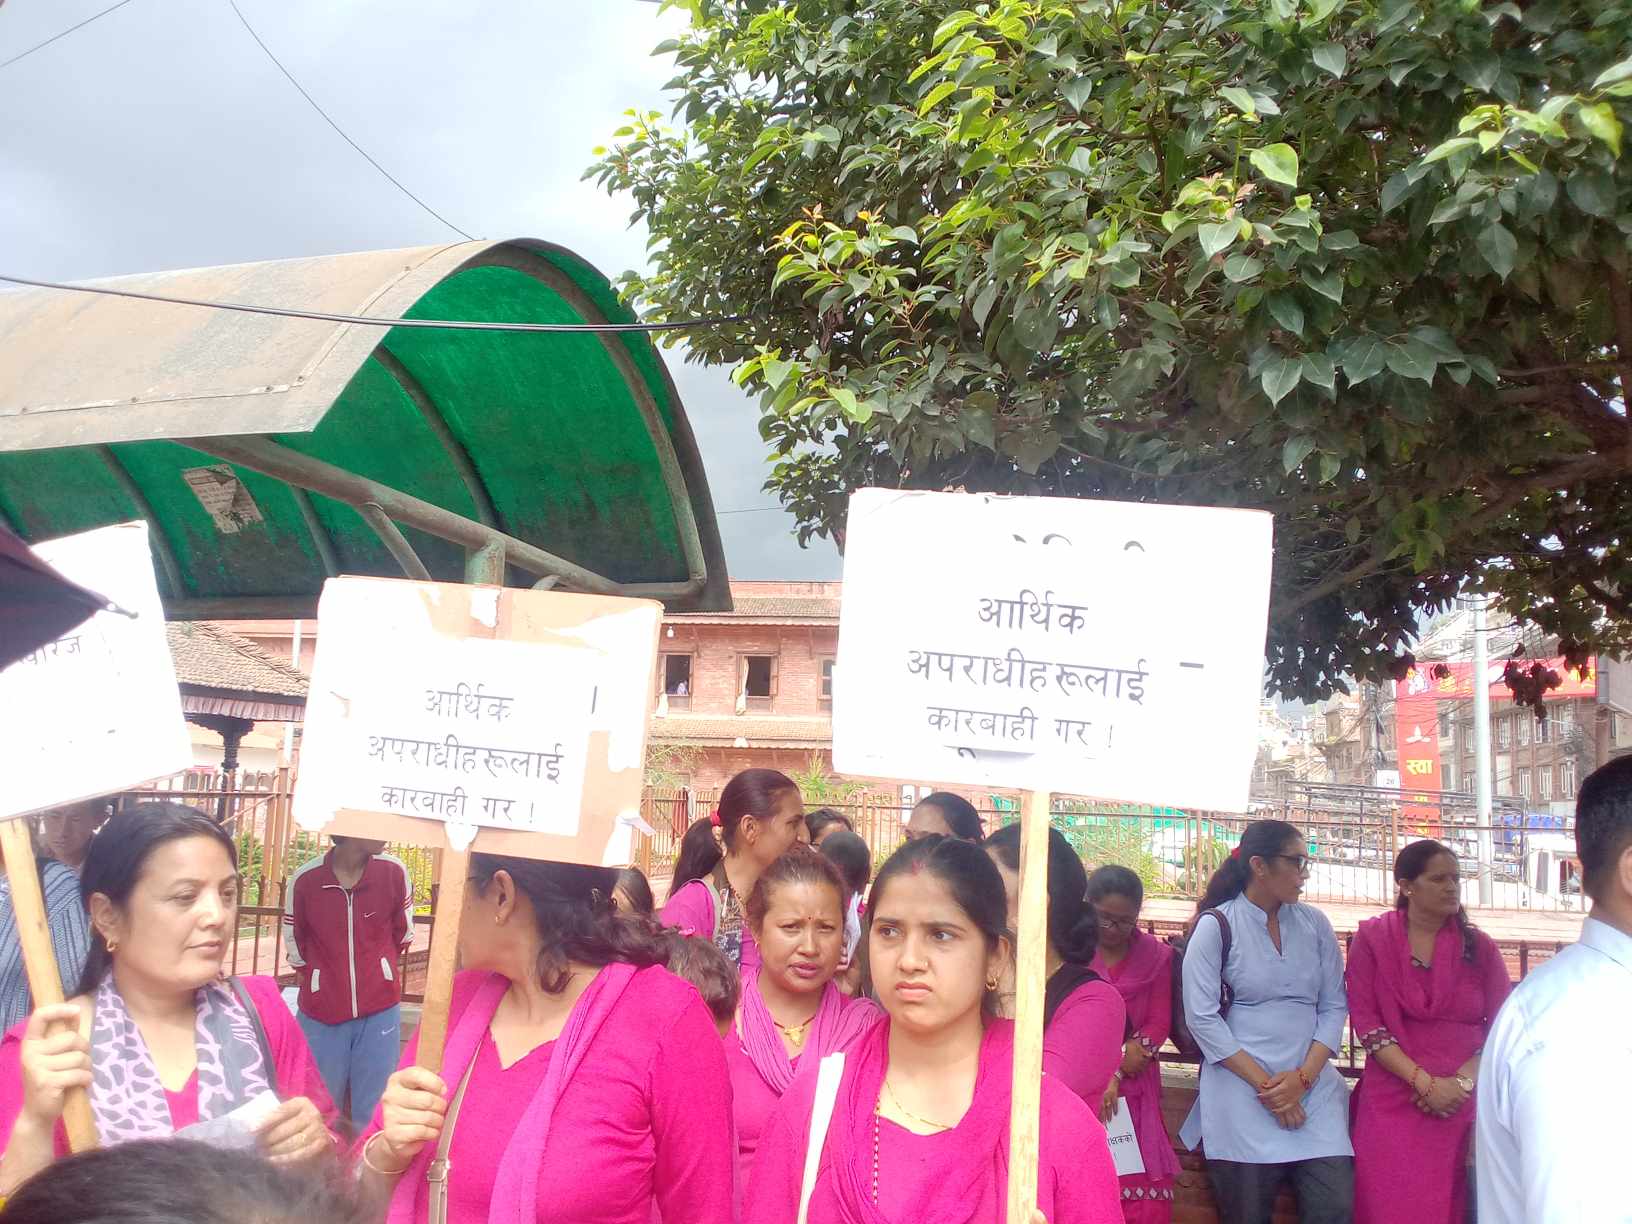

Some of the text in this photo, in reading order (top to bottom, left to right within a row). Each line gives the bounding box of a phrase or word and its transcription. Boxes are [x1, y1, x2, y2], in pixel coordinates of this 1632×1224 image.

[978, 588, 1088, 635] आर्थिक
[907, 647, 1149, 705] अपराधीहरूलाई
[426, 682, 514, 722] आर्थिक
[1054, 719, 1092, 746] गर
[368, 734, 564, 784] अपराधीहरूलाई
[481, 797, 517, 822] गर
